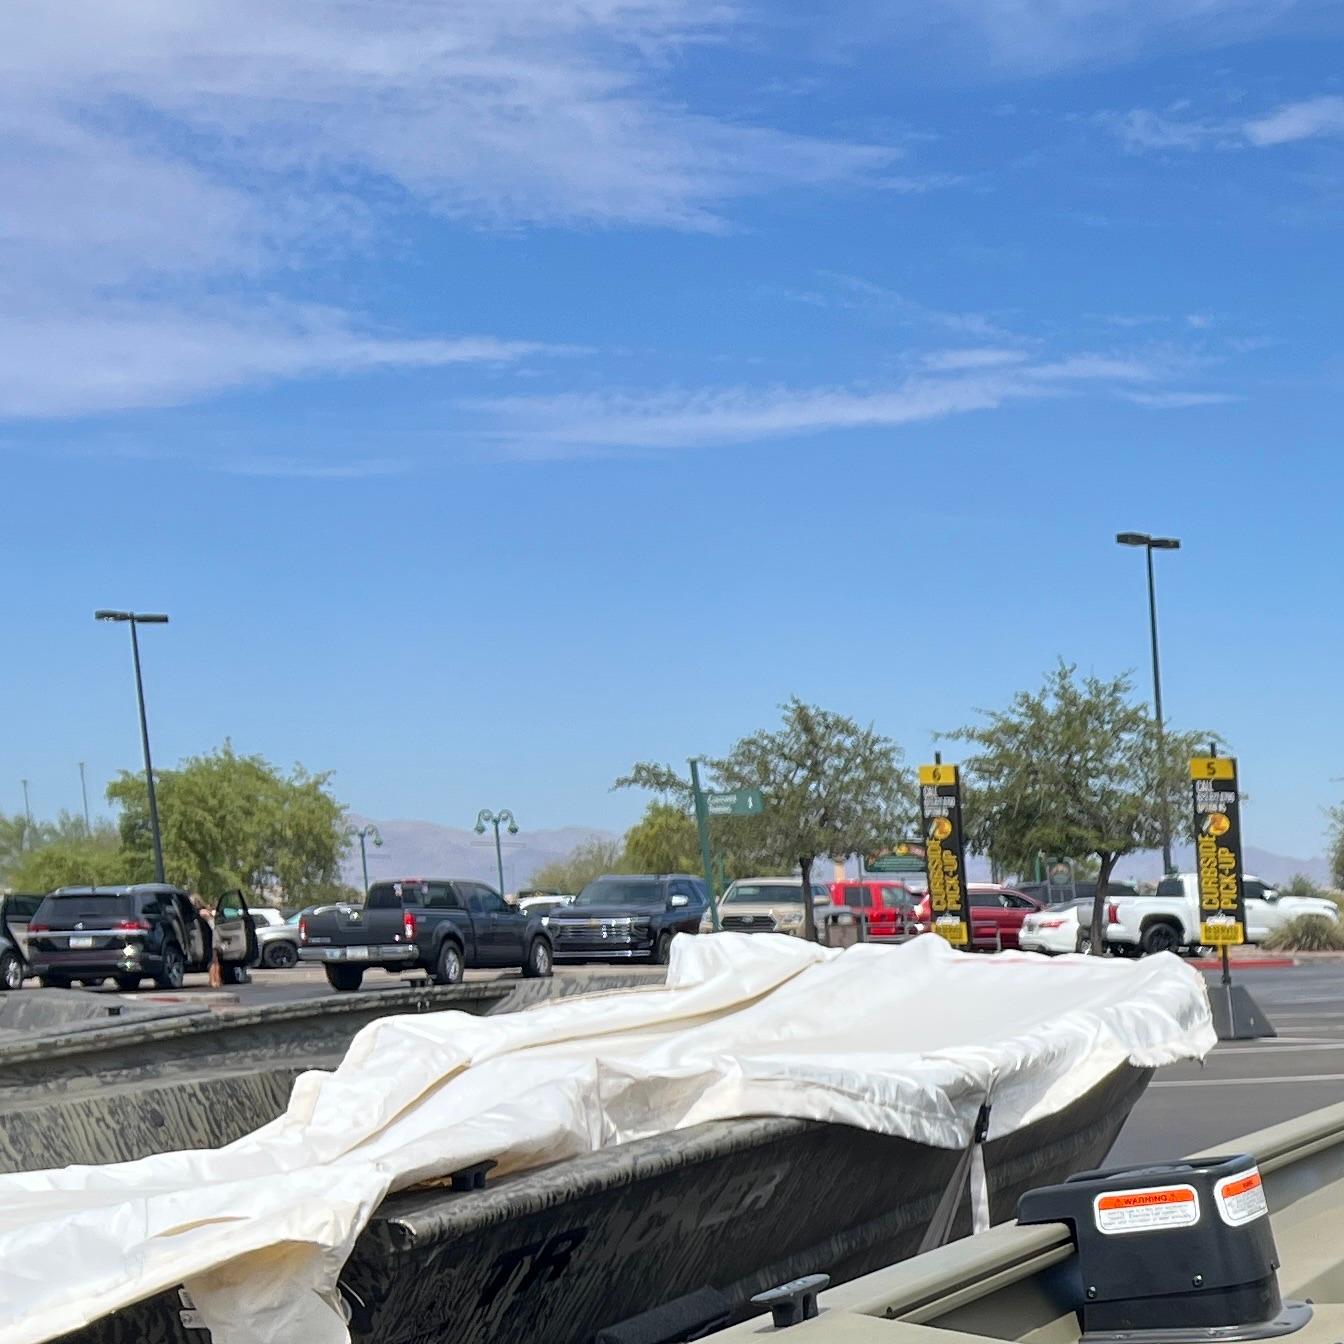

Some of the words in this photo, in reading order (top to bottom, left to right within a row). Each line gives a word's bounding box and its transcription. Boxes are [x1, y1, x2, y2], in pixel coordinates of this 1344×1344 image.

[932, 768, 941, 781] 6
[1207, 762, 1216, 775] 5
[1198, 833, 1219, 910] CURBSIDE
[1218, 847, 1238, 911] PICK-UP
[1123, 1194, 1167, 1206] WARNING
